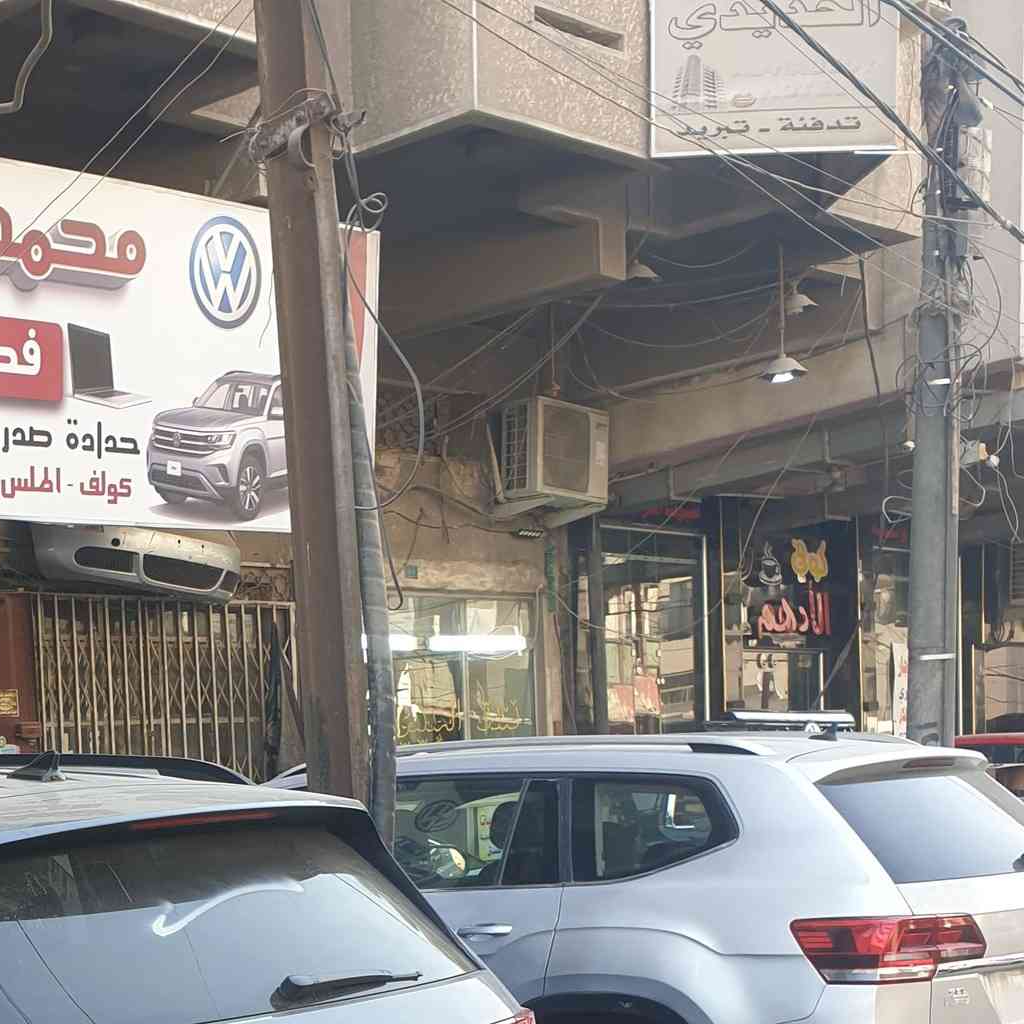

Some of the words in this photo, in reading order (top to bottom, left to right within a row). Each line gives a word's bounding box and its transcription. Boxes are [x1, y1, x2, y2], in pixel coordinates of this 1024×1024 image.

[2, 426, 53, 453] صدر
[65, 418, 141, 459] حدادة
[1, 465, 61, 498] اطلس
[79, 470, 132, 505] كولف
